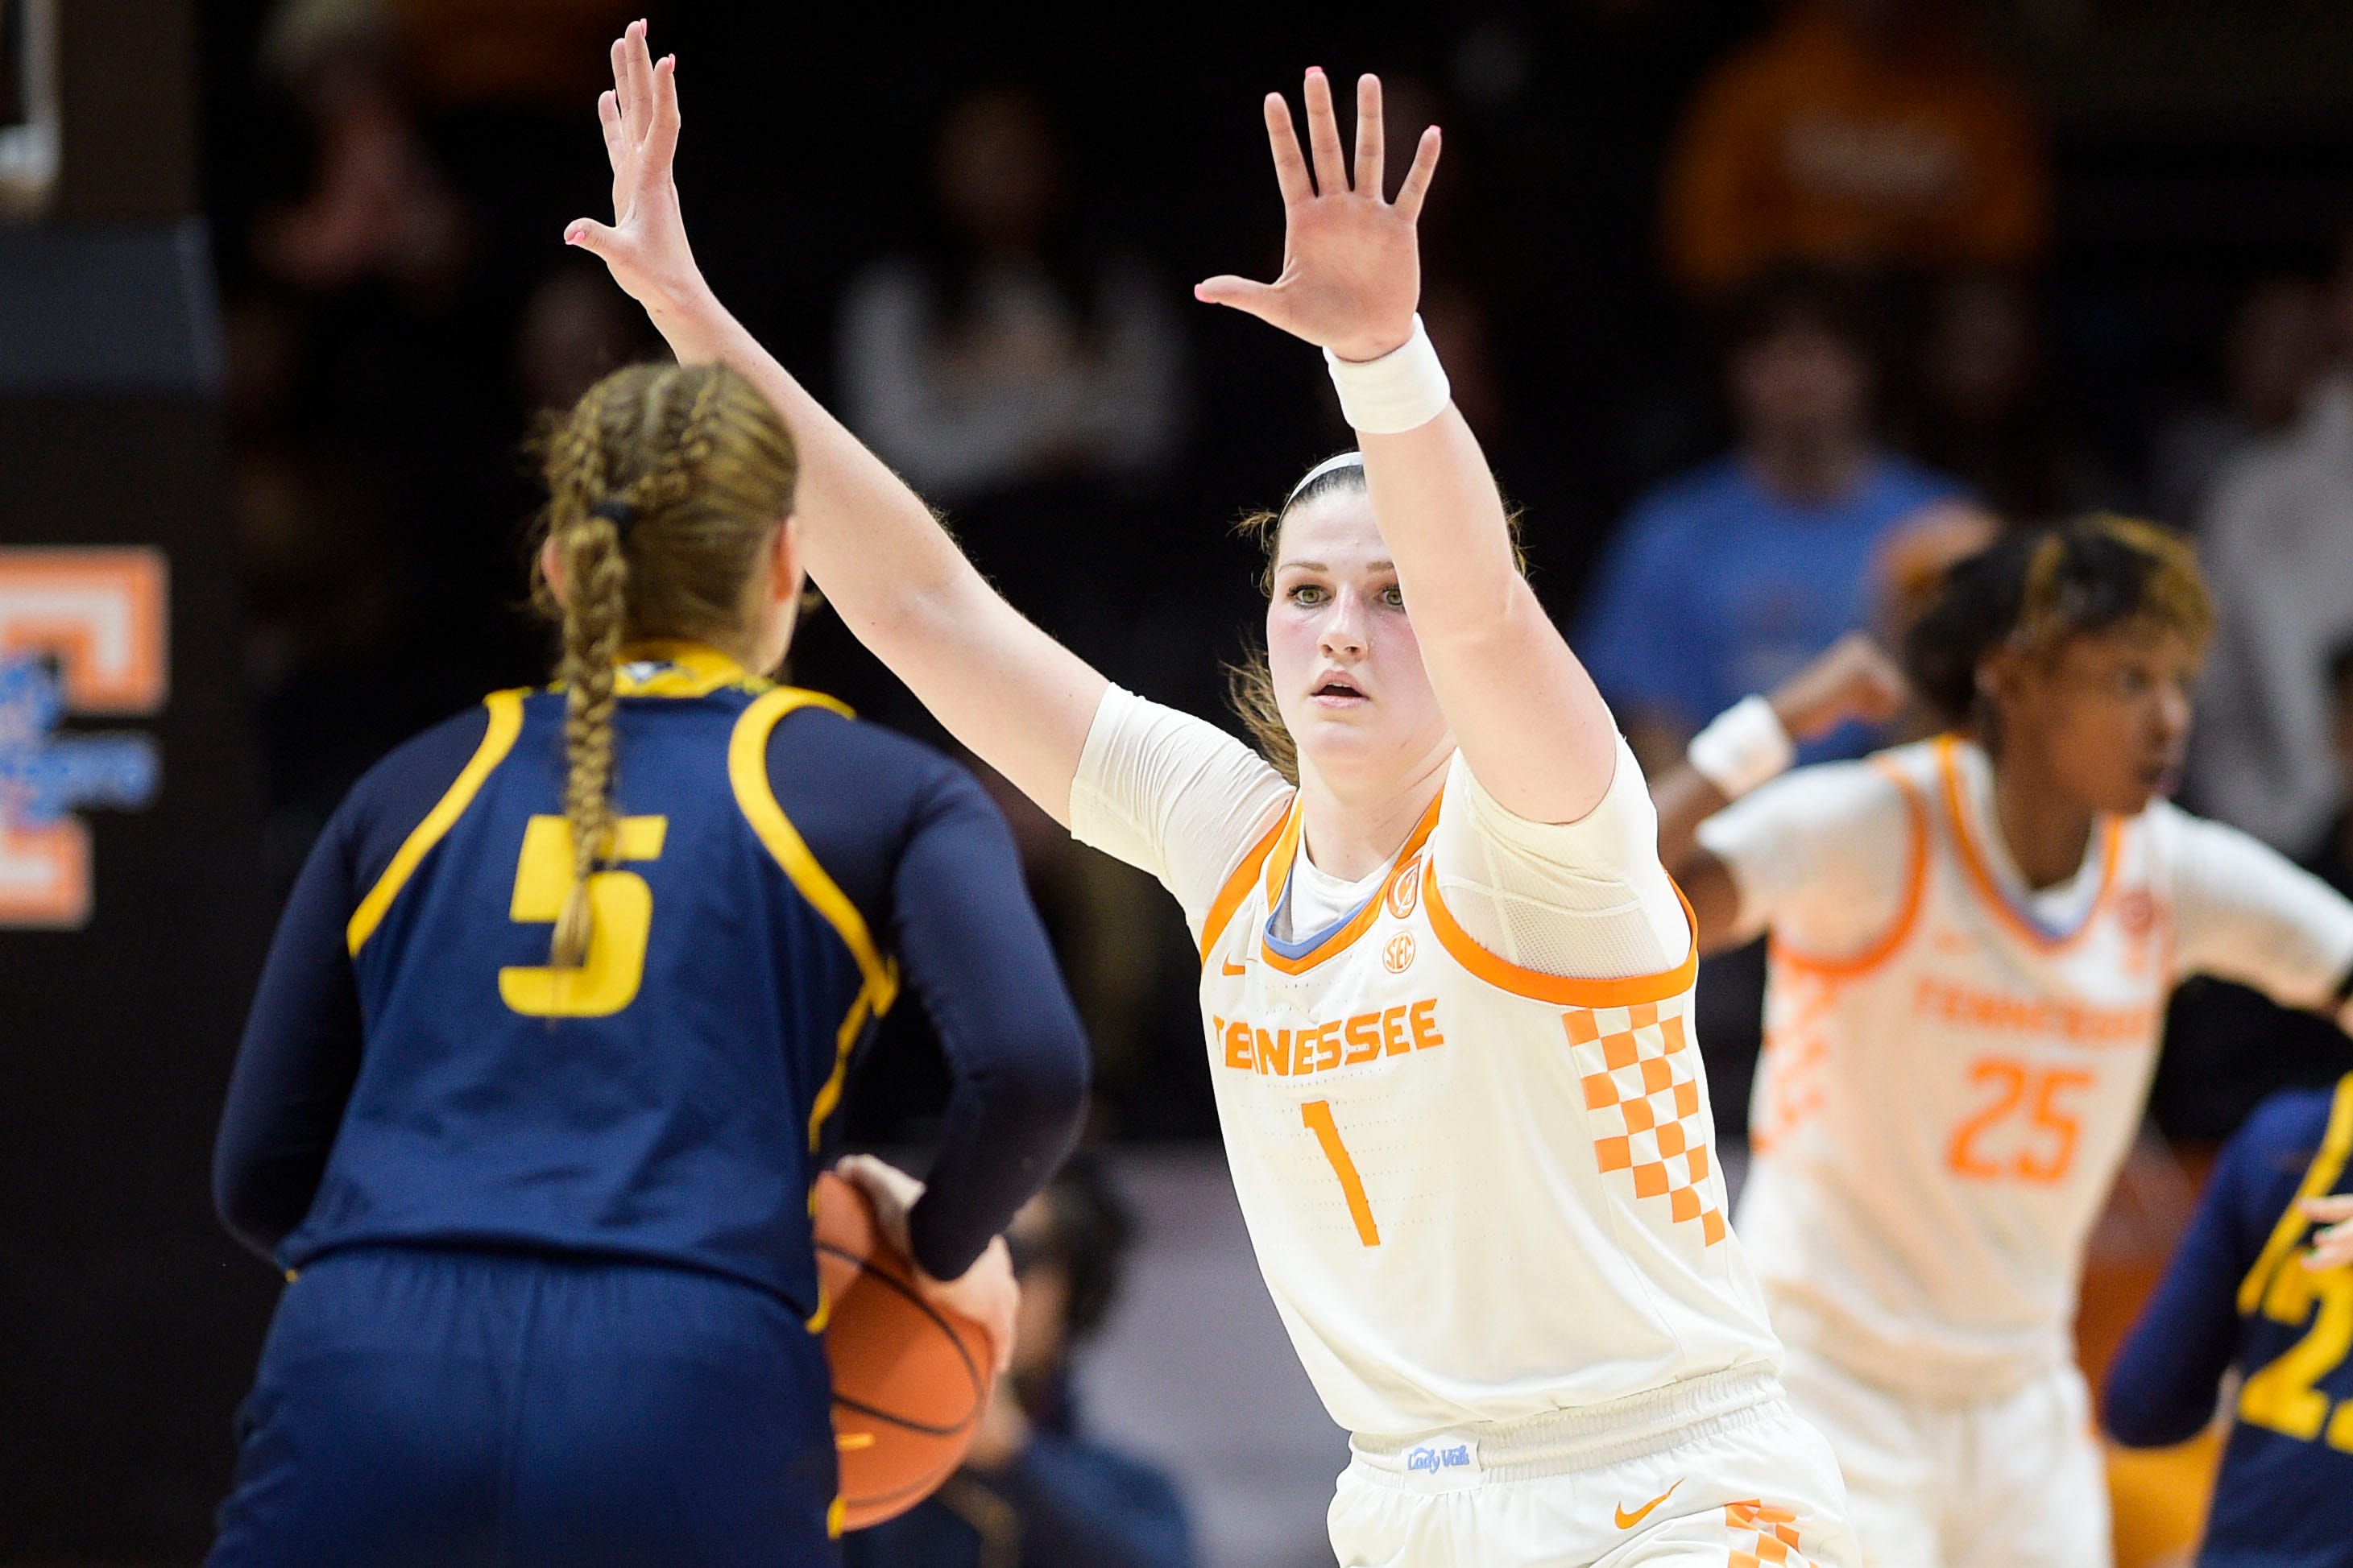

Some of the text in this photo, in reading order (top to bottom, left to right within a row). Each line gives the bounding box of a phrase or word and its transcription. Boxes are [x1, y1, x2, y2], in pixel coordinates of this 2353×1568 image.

[499, 814, 669, 1017] 5
[1386, 934, 1411, 970] SEC
[1212, 997, 1444, 1076] ENESSEE
[1301, 1100, 1381, 1247] 1
[1945, 1055, 2096, 1182] 25
[2238, 1247, 2353, 1454] 2
